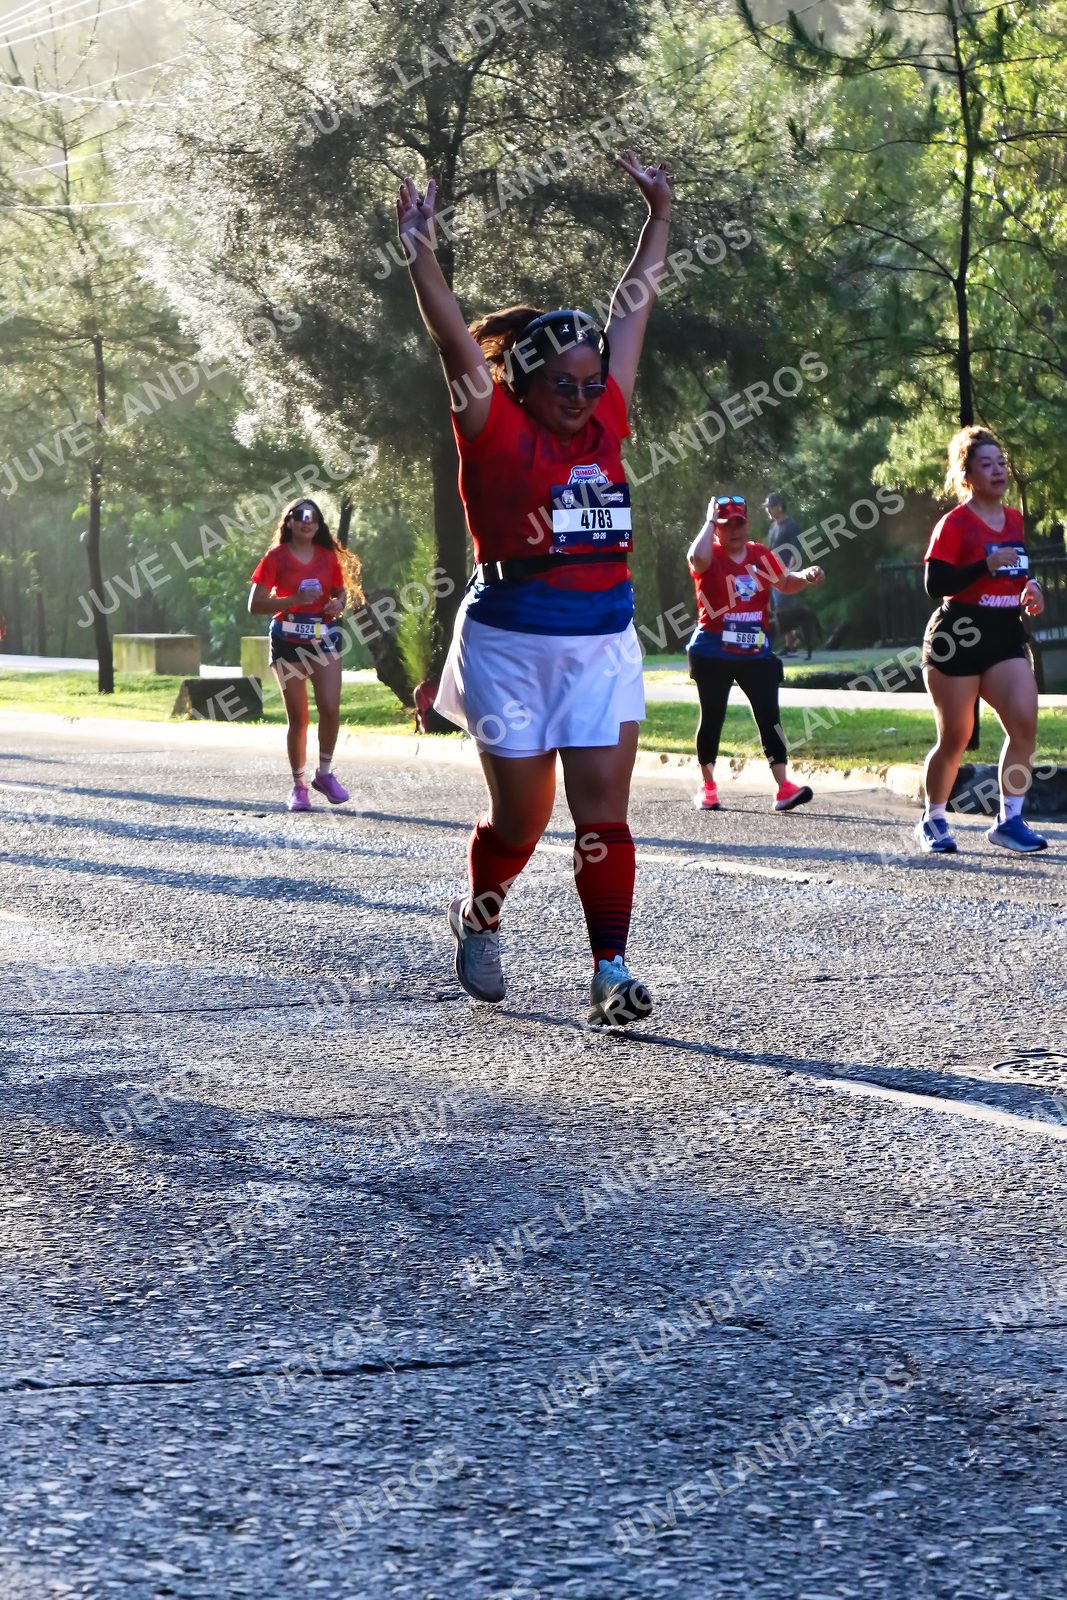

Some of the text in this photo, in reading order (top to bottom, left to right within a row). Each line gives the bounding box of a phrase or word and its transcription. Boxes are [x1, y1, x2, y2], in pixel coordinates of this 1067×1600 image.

[575, 468, 597, 476] BIMBO
[581, 509, 613, 529] 4783
[295, 624, 314, 634] 4524
